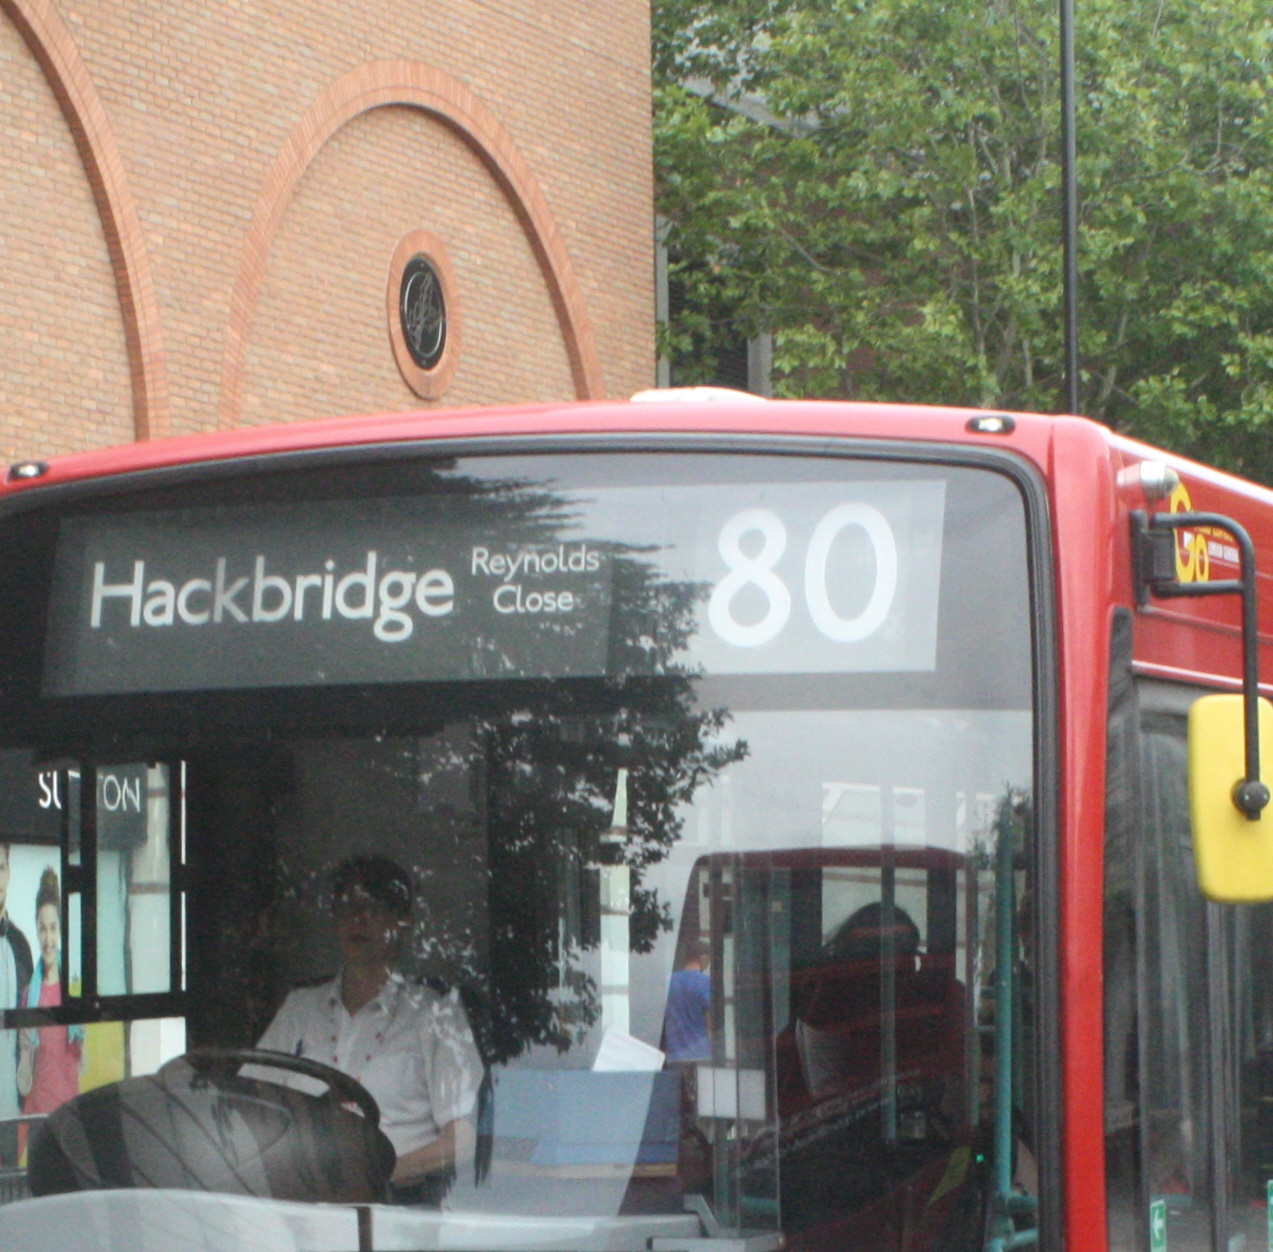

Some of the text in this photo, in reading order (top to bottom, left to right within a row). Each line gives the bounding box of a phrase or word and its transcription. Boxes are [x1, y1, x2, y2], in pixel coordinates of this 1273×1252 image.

[90, 549, 455, 643] Hackbridge
[471, 544, 600, 582] Reynolds
[708, 502, 897, 647] 80
[493, 585, 574, 614] Close
